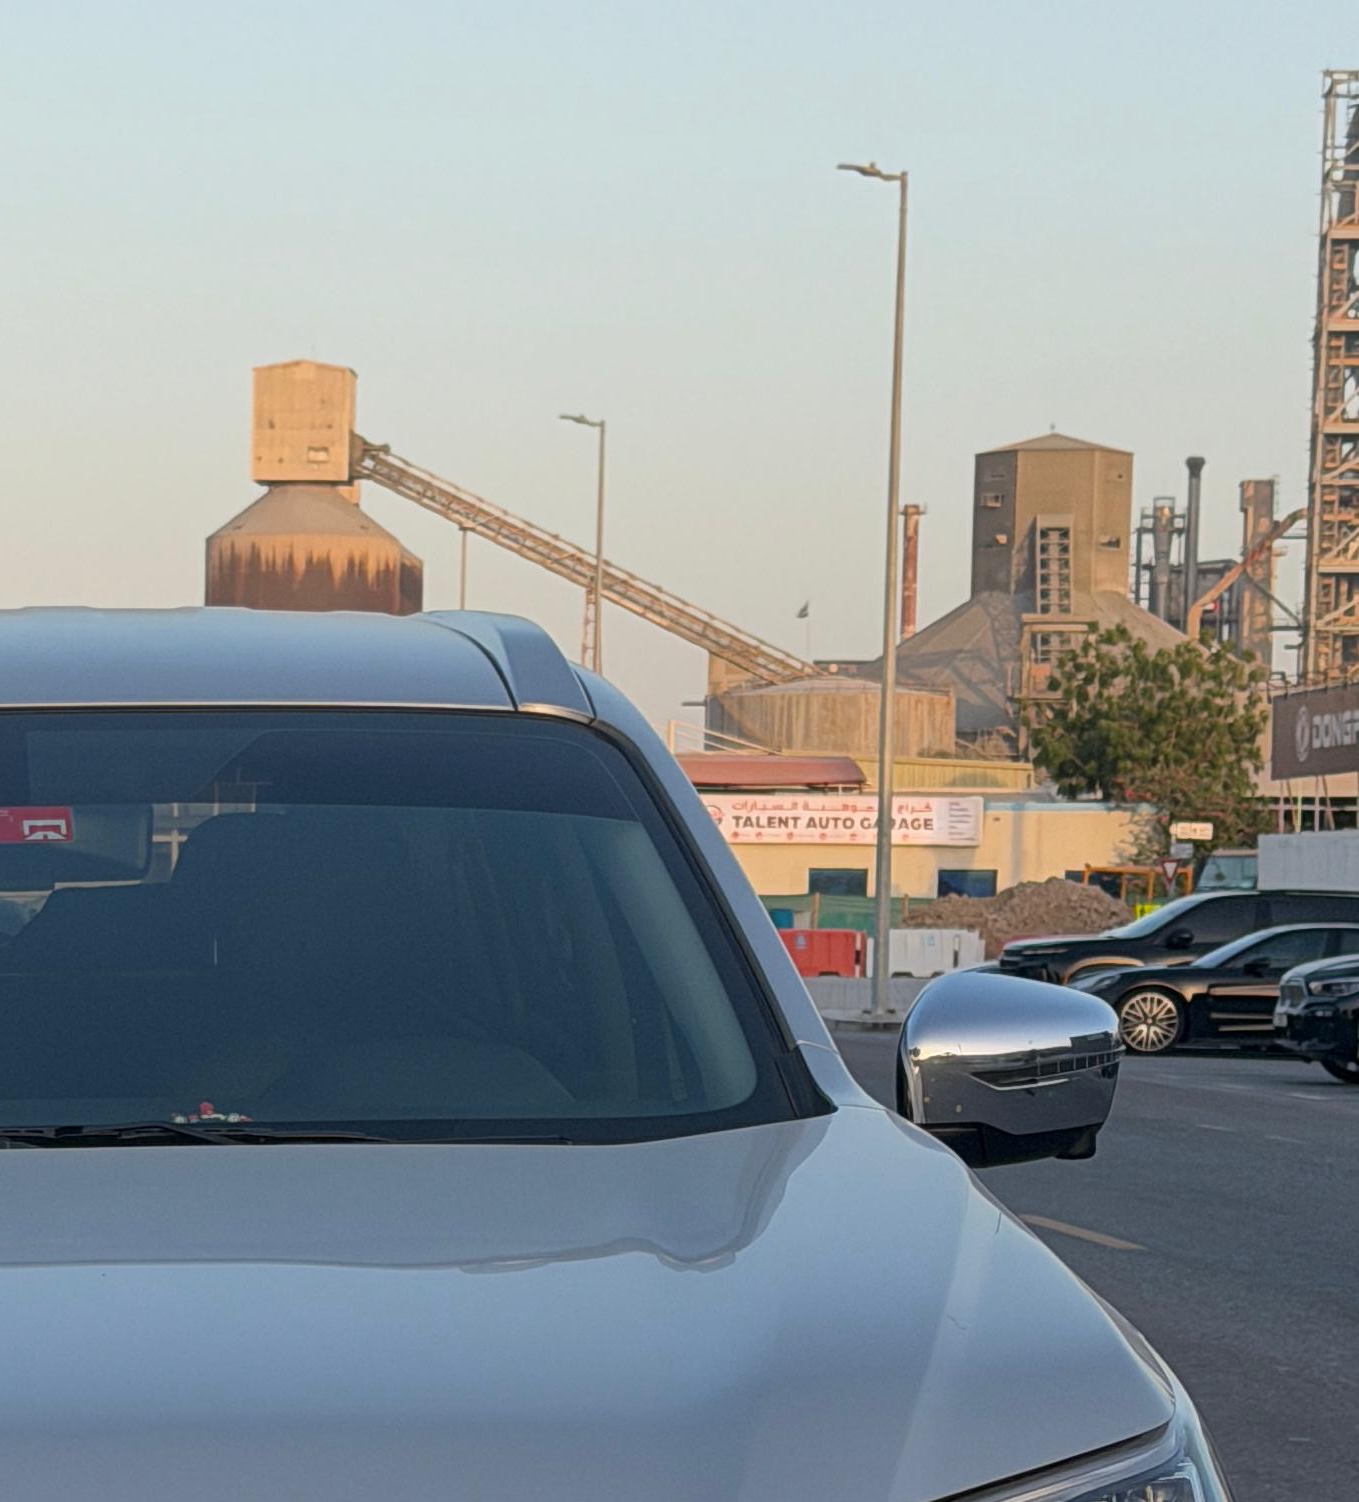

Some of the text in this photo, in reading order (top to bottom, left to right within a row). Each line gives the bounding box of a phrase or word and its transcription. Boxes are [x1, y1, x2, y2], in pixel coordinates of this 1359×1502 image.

[731, 815, 934, 831] TALENT AUTO GAGE
